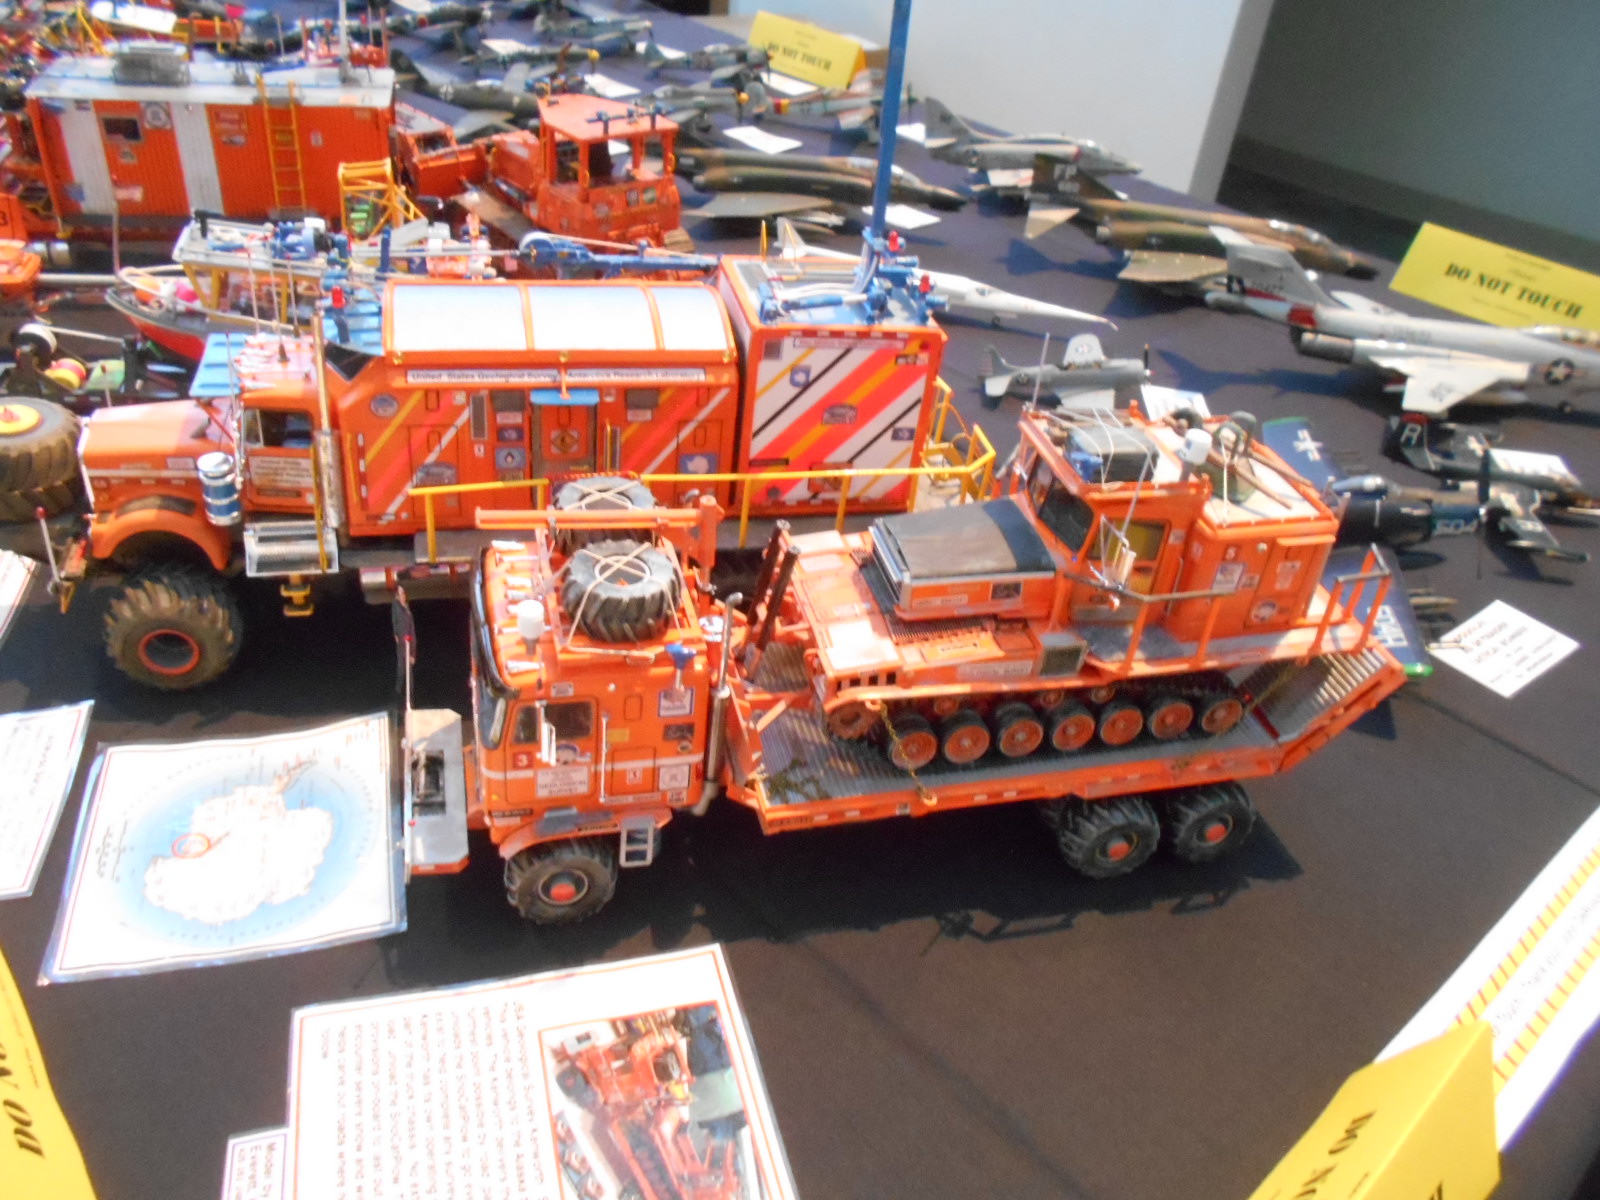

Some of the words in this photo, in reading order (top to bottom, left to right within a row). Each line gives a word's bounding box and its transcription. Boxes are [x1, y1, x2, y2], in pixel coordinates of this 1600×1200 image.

[1445, 263, 1471, 281] DO
[1475, 272, 1513, 295] NOT
[1517, 287, 1584, 319] TOUCH
[518, 754, 527, 767] 3
